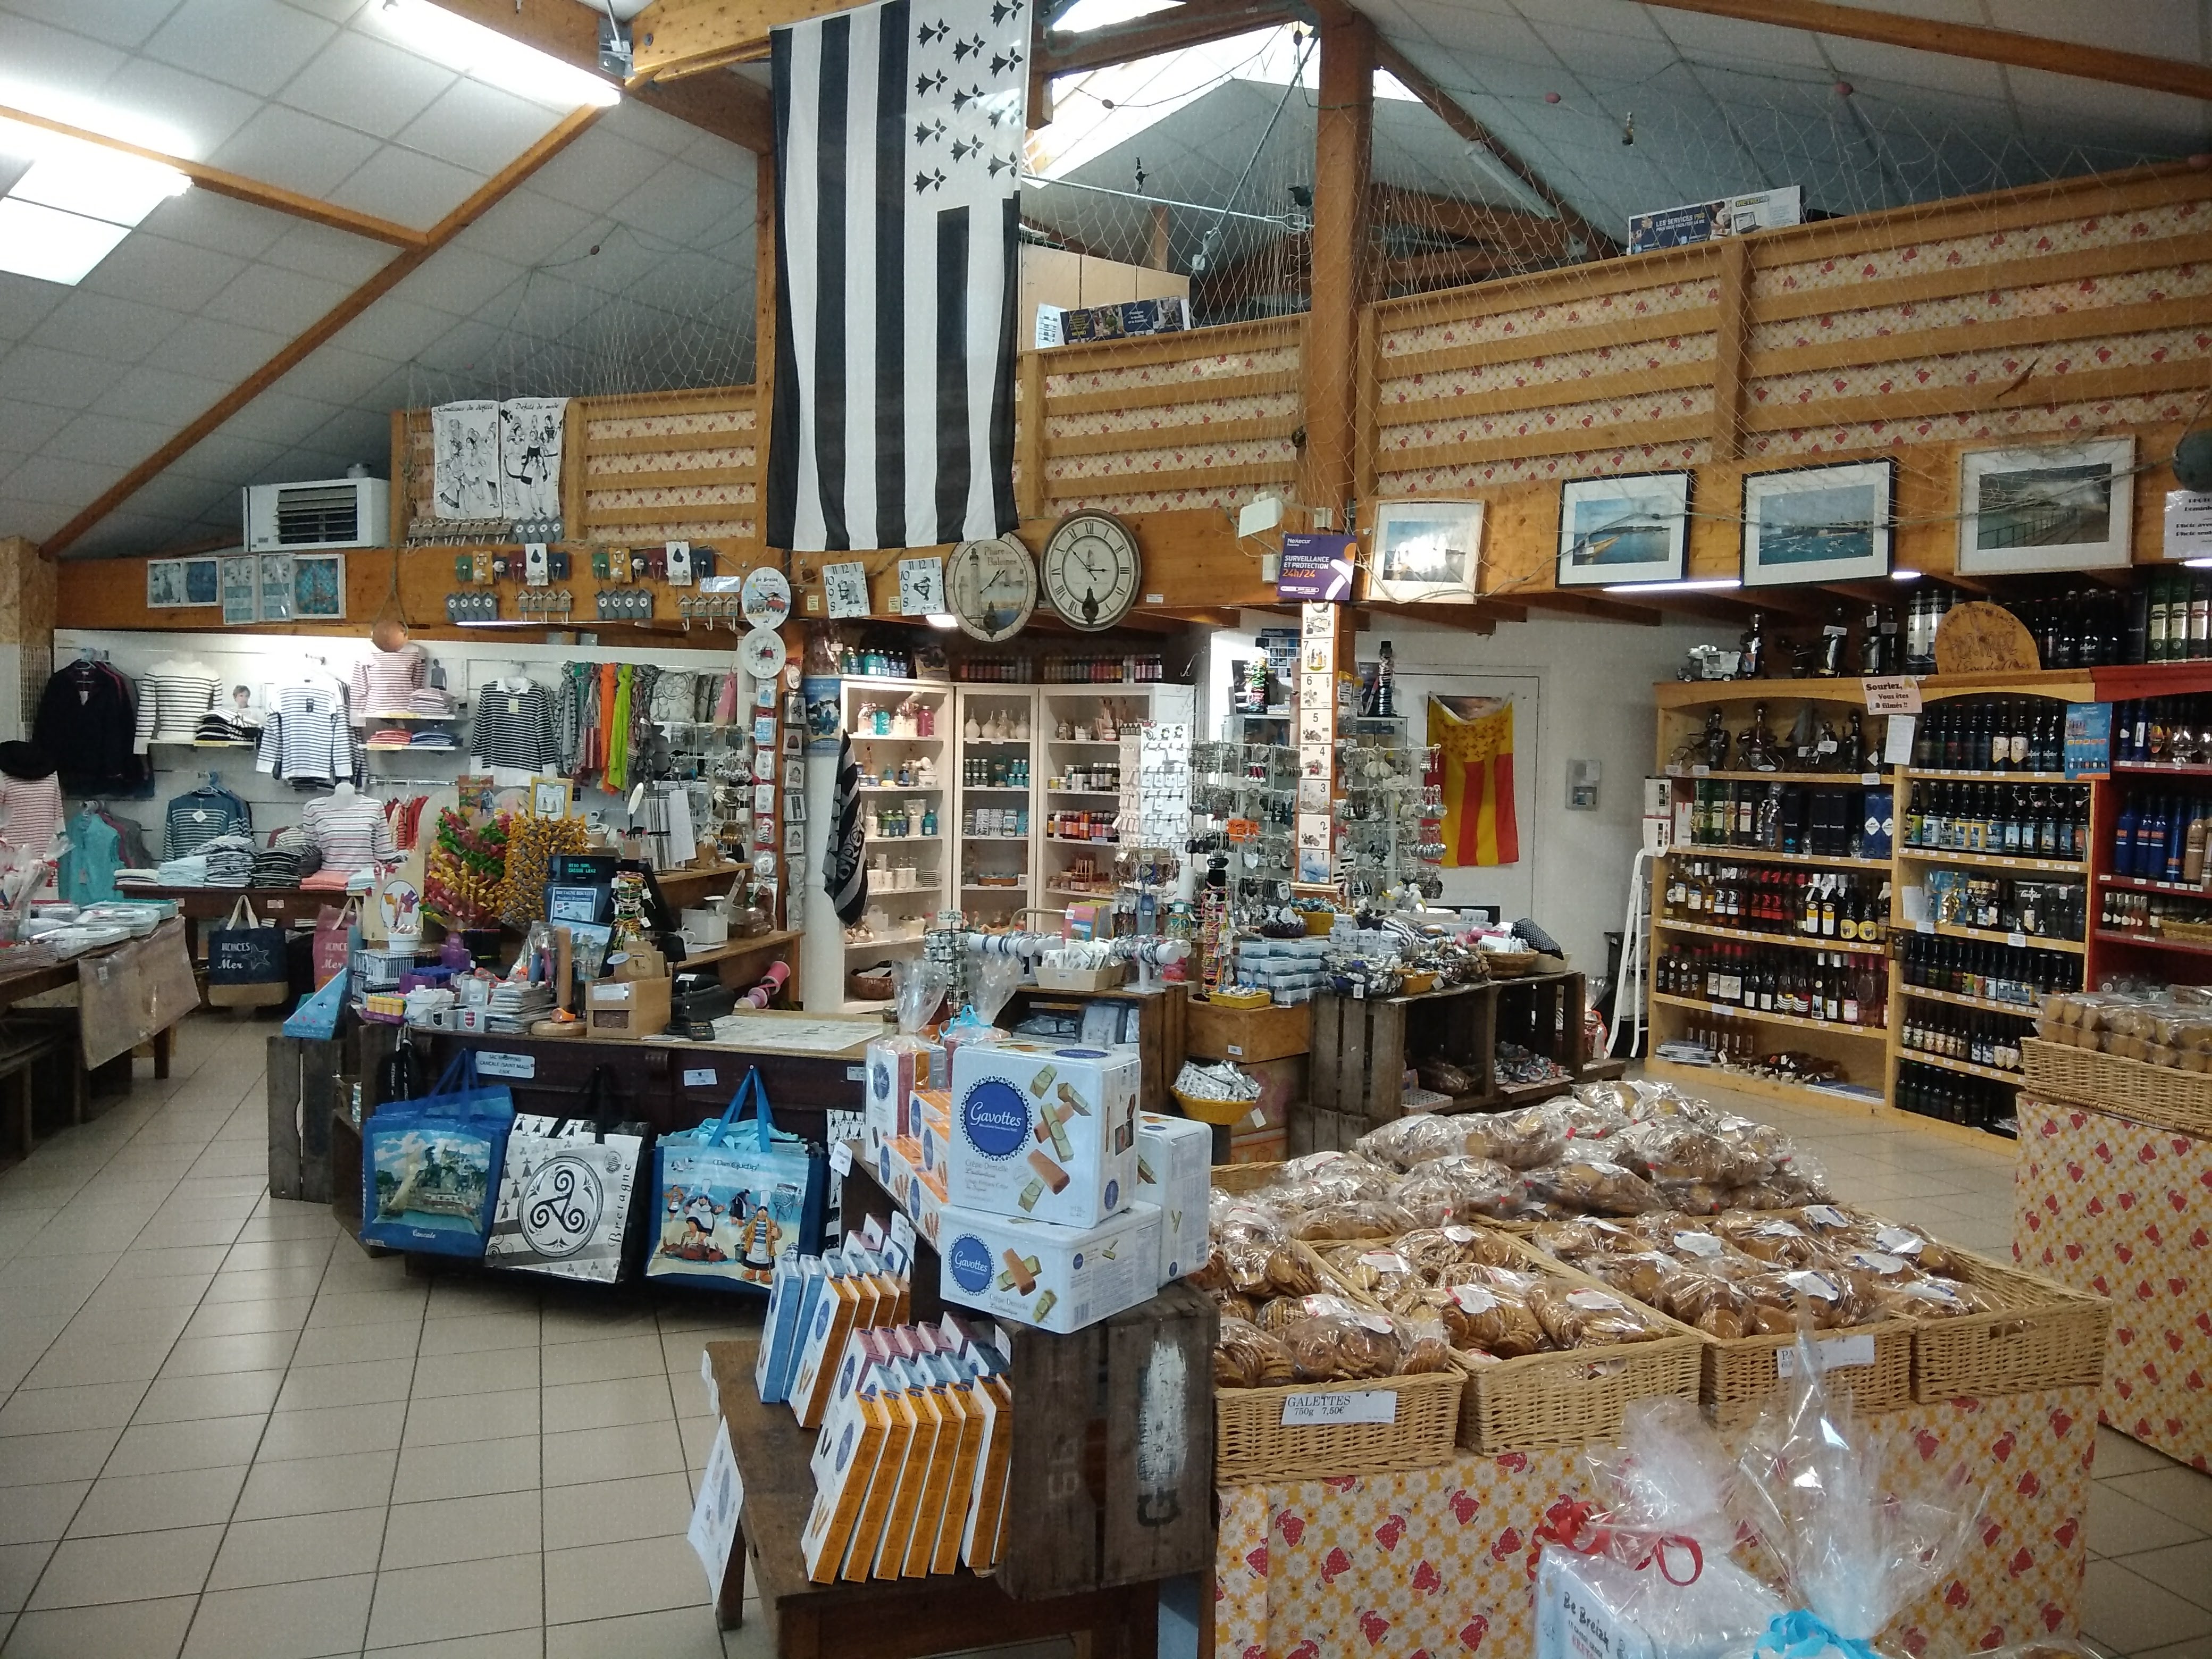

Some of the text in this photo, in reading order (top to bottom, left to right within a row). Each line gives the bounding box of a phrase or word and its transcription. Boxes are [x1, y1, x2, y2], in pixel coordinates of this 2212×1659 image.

[1668, 215, 1693, 225] SERVICES
[1282, 569, 1316, 579] 24h/24
[1303, 641, 1309, 650] 7
[1306, 676, 1312, 685] 6
[1866, 682, 1903, 691] Souriez,
[1313, 713, 1318, 722] 5
[1319, 747, 1325, 756] 4
[1320, 783, 1326, 793] 3
[1320, 820, 1328, 831] 2
[1321, 851, 1325, 861] 1
[325, 942, 348, 951] VACANCE
[218, 959, 244, 969] Mer
[322, 959, 343, 968] Mer
[970, 1101, 1021, 1127] Gavottes
[966, 1159, 1008, 1171] Crêpe Dentelle
[607, 1163, 632, 1247] Bretagne
[412, 1229, 436, 1238] Cancale
[955, 1251, 988, 1272] Gavottes
[990, 1293, 1029, 1310] Crêpe Dentelle
[1288, 1395, 1351, 1407] GALETTES
[1294, 1406, 1345, 1416] 750g 7,50€
[1564, 1591, 1576, 1614] Be
[1579, 1607, 1610, 1653] Breizh
